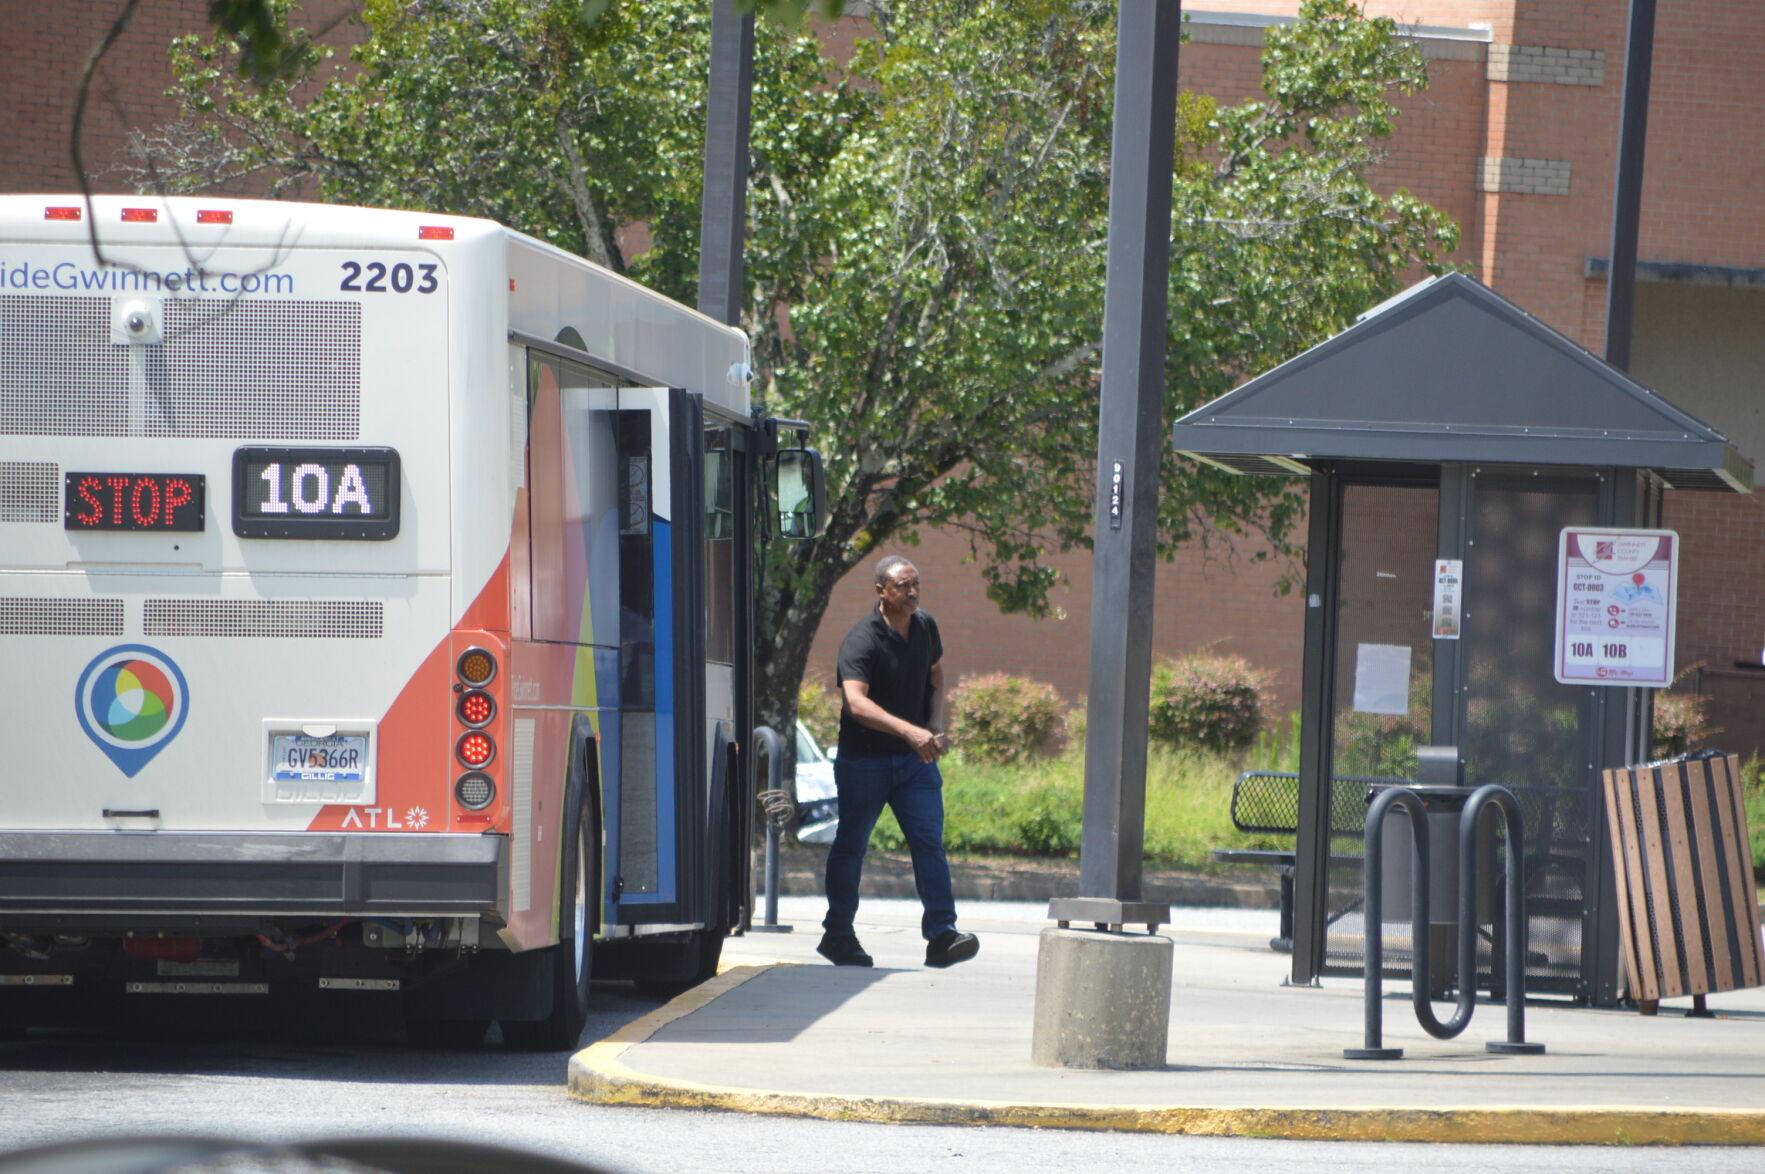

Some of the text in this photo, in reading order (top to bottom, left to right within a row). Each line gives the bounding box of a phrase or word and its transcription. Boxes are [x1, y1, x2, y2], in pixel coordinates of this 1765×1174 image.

[340, 261, 439, 293] 2203
[76, 475, 192, 526] STOP
[260, 463, 372, 514] 10A
[1111, 462, 1121, 515] 90124
[1573, 583, 1604, 592] GCT-0003
[1571, 642, 1627, 659] 10A 10B
[288, 748, 359, 769] GV5366R
[341, 808, 402, 828] ATL
